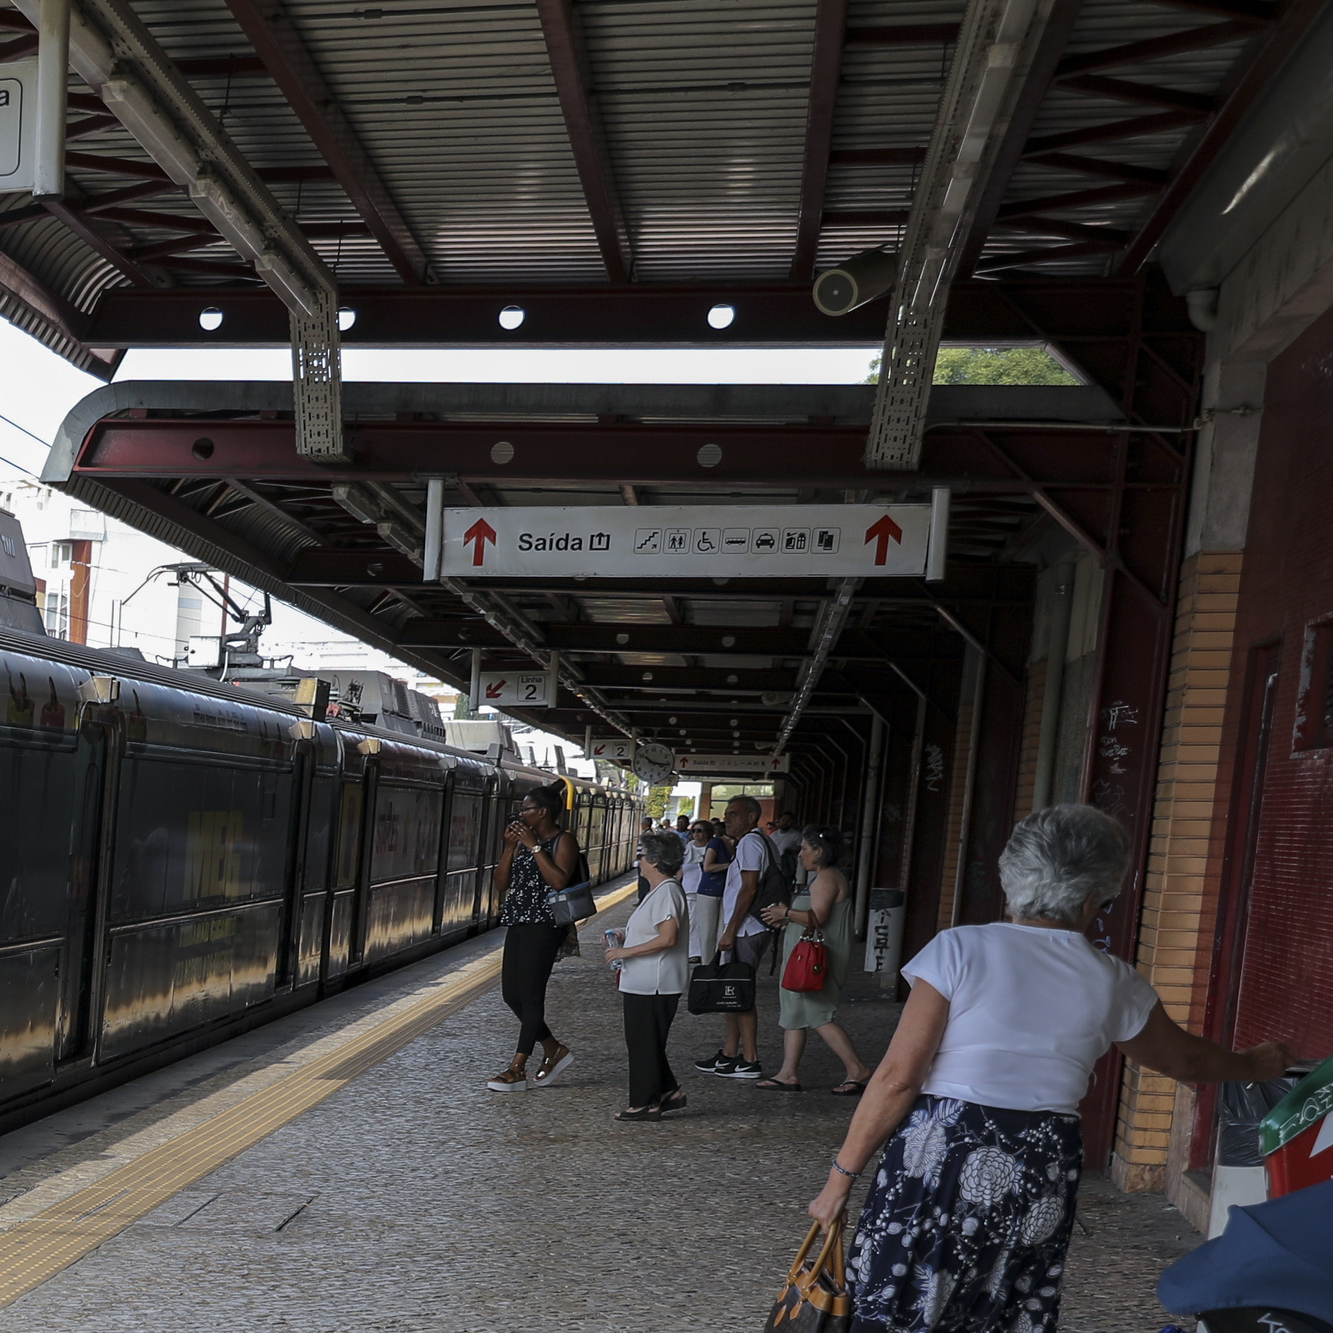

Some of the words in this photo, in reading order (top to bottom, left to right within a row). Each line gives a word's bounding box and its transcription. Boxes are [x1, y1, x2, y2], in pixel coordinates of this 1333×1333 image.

[517, 532, 583, 552] Saída
[521, 676, 542, 684] Linha
[525, 684, 537, 700] 2
[617, 746, 625, 756] 2
